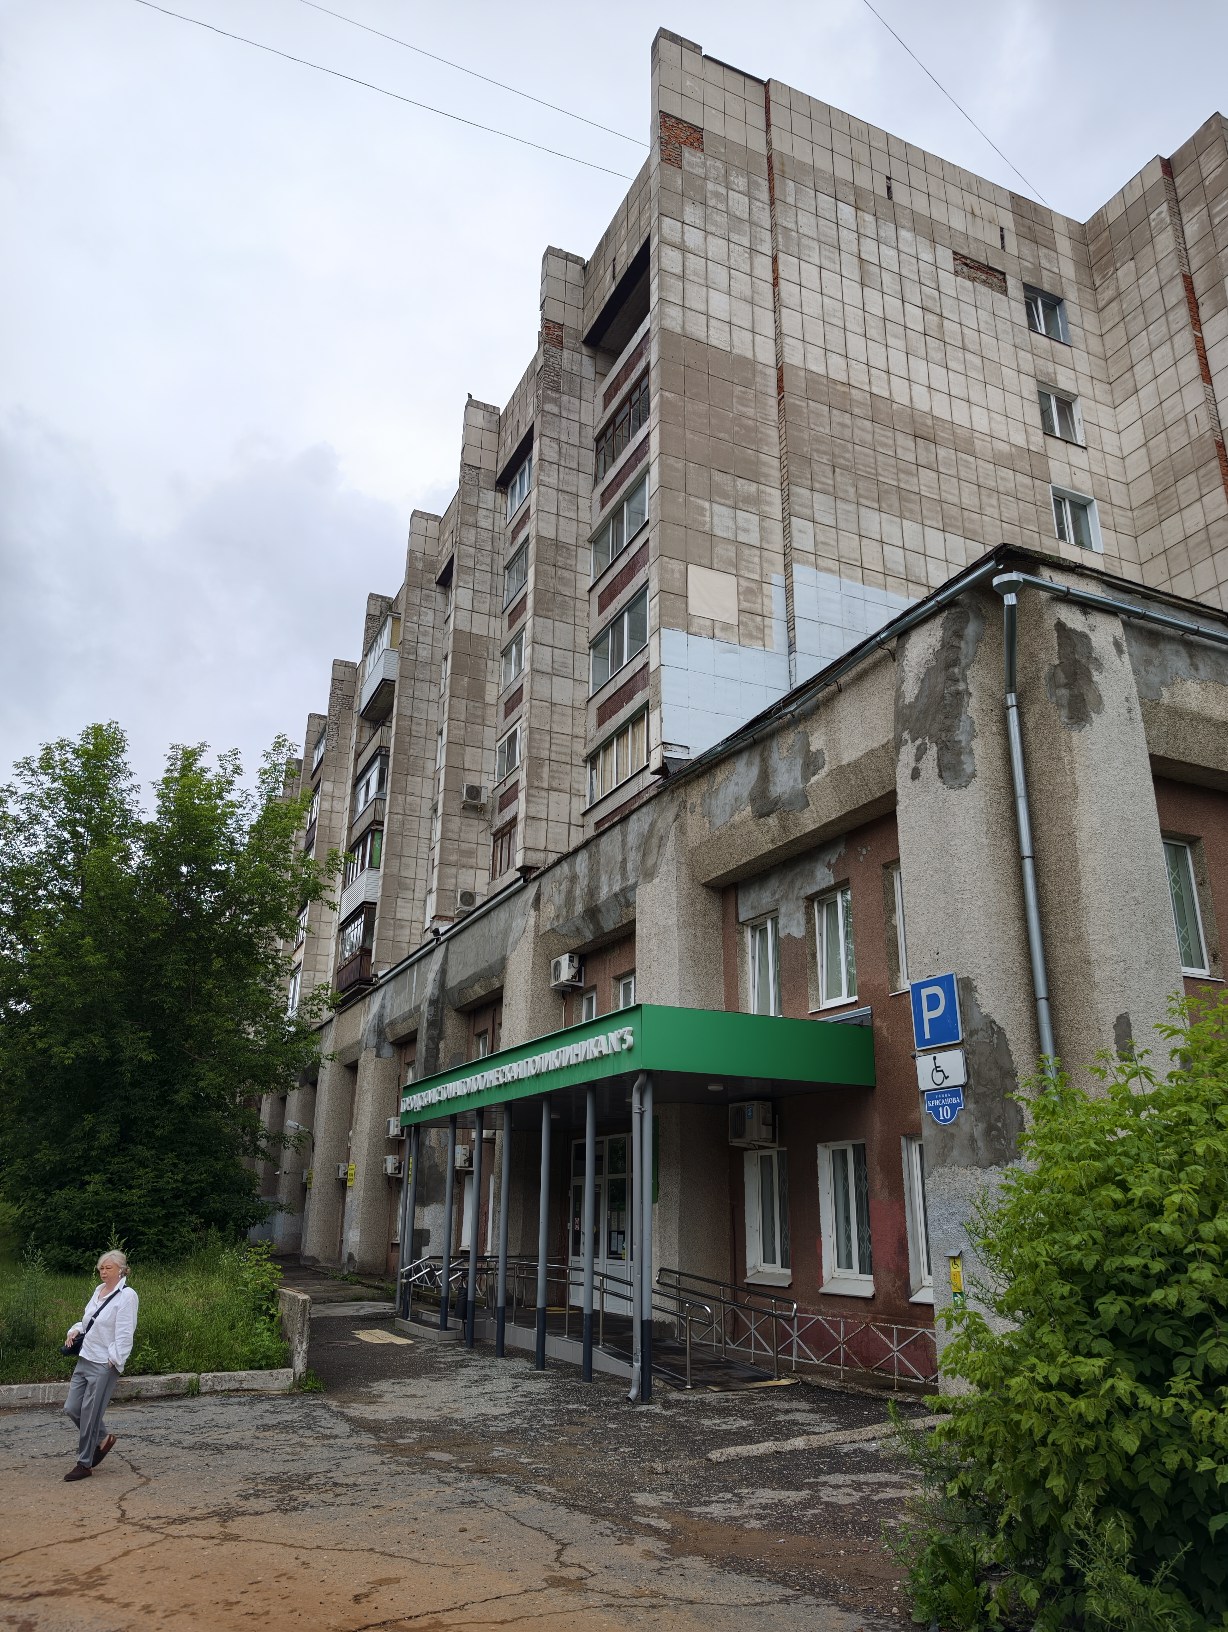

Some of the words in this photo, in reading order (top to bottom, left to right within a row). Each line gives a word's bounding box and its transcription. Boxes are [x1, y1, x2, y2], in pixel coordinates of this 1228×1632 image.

[921, 985, 946, 1039] P
[521, 1034, 609, 1079] ПОЛИКЛИНИКА
[938, 1105, 951, 1120] 10
